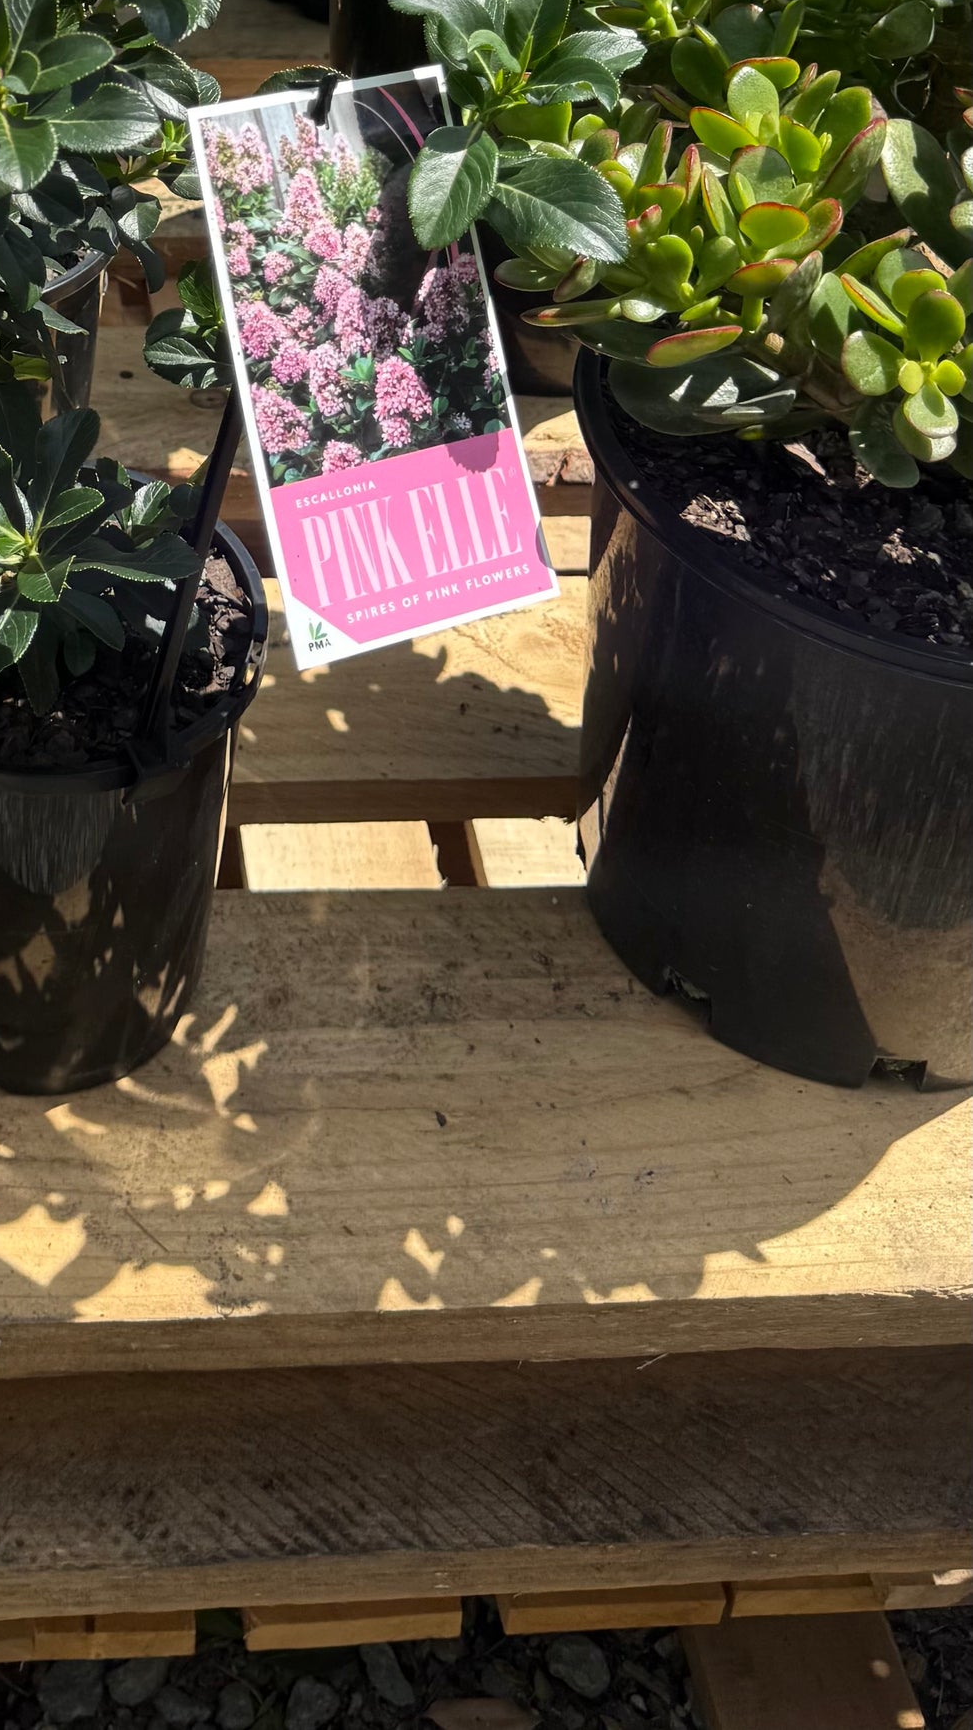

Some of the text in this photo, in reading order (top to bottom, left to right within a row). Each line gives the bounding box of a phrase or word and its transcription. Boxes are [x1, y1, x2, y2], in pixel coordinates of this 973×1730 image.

[295, 480, 376, 509] ESCALLONIA
[300, 467, 523, 608] PINK ELLE
[347, 563, 530, 624] SPIRES OF PINK FLOWERS
[308, 640, 332, 652] PMA
